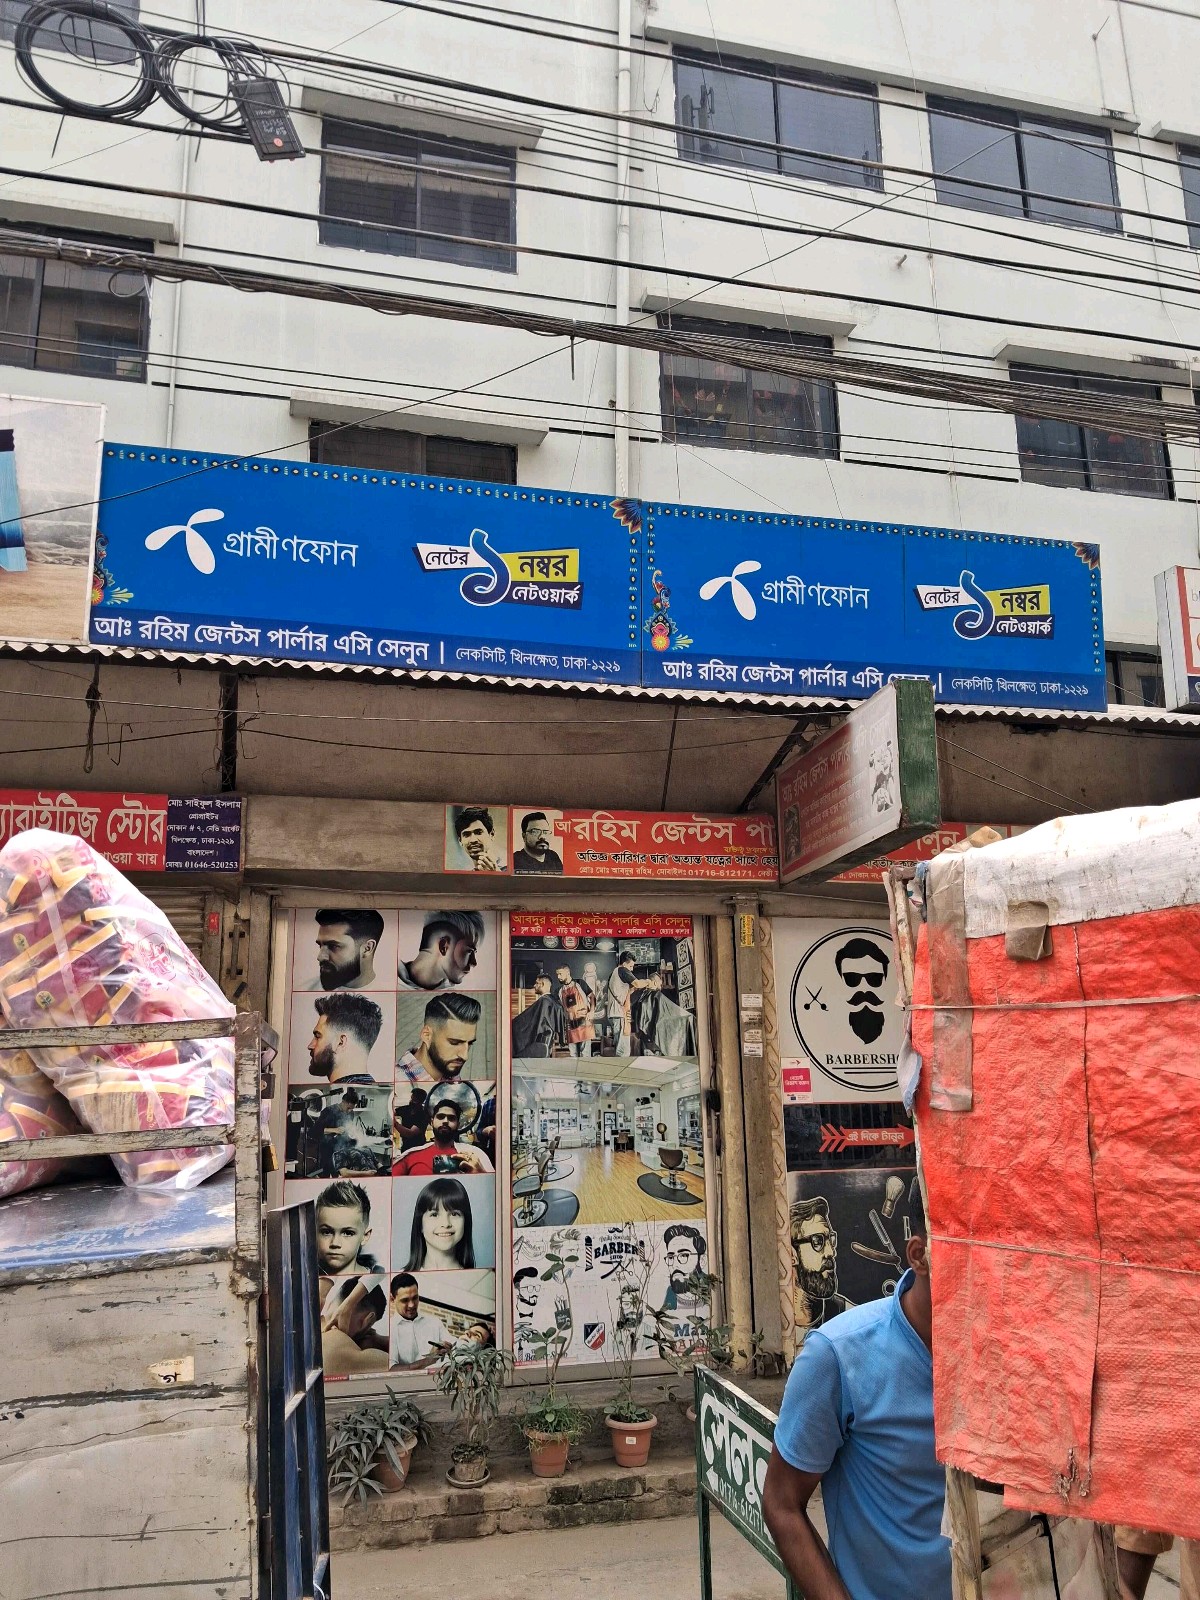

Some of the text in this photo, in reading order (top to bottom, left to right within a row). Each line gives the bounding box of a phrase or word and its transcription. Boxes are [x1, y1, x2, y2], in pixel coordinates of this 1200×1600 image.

[223, 526, 359, 568] গ্রামীণফোন
[425, 547, 470, 566] নেটের
[518, 554, 569, 578] নম্বর
[512, 583, 582, 605] নেটওয়ার্ক
[761, 575, 871, 610] গ্রামীণফোন
[924, 588, 961, 604] নেটের
[1000, 590, 1041, 613] নম্বর
[996, 616, 1053, 635] নেটওয়ার্ক
[94, 615, 621, 672] আঃ রহিম জেন্টস পার্লার এসি সেলুন লেকসিটি, খিলক্ষেত, ঢাকা-১২২৯
[662, 660, 693, 680] আঃ
[697, 658, 739, 682] রহিম
[741, 661, 794, 685] জেন্টস
[798, 663, 848, 688] পার্লার
[852, 667, 884, 689] এসি
[997, 677, 1038, 695] খিলক্ষেত,
[1040, 681, 1090, 696] ঢাকা-১২২৯
[185, 798, 213, 810] সাইফুল
[215, 798, 242, 809] ইসলাম
[106, 794, 167, 846] স্টোর
[571, 810, 642, 847] রহিম
[651, 813, 737, 846] জেন্টস
[745, 820, 777, 847] পা
[136, 852, 159, 865] যায়
[184, 861, 239, 869] 01646-520253
[576, 848, 609, 863] অভিজ্ঞ
[610, 850, 647, 865] কারিগর
[649, 853, 669, 865] দ্বারা
[735, 854, 759, 867] সাথে
[761, 855, 779, 868] হেয়
[871, 872, 882, 880] নং-
[512, 913, 691, 929] আবদুর রহিম জেন্টস পার্লার এসি সেলুন
[826, 1053, 899, 1066] BARBERSH
[594, 1241, 639, 1260] BARBER
